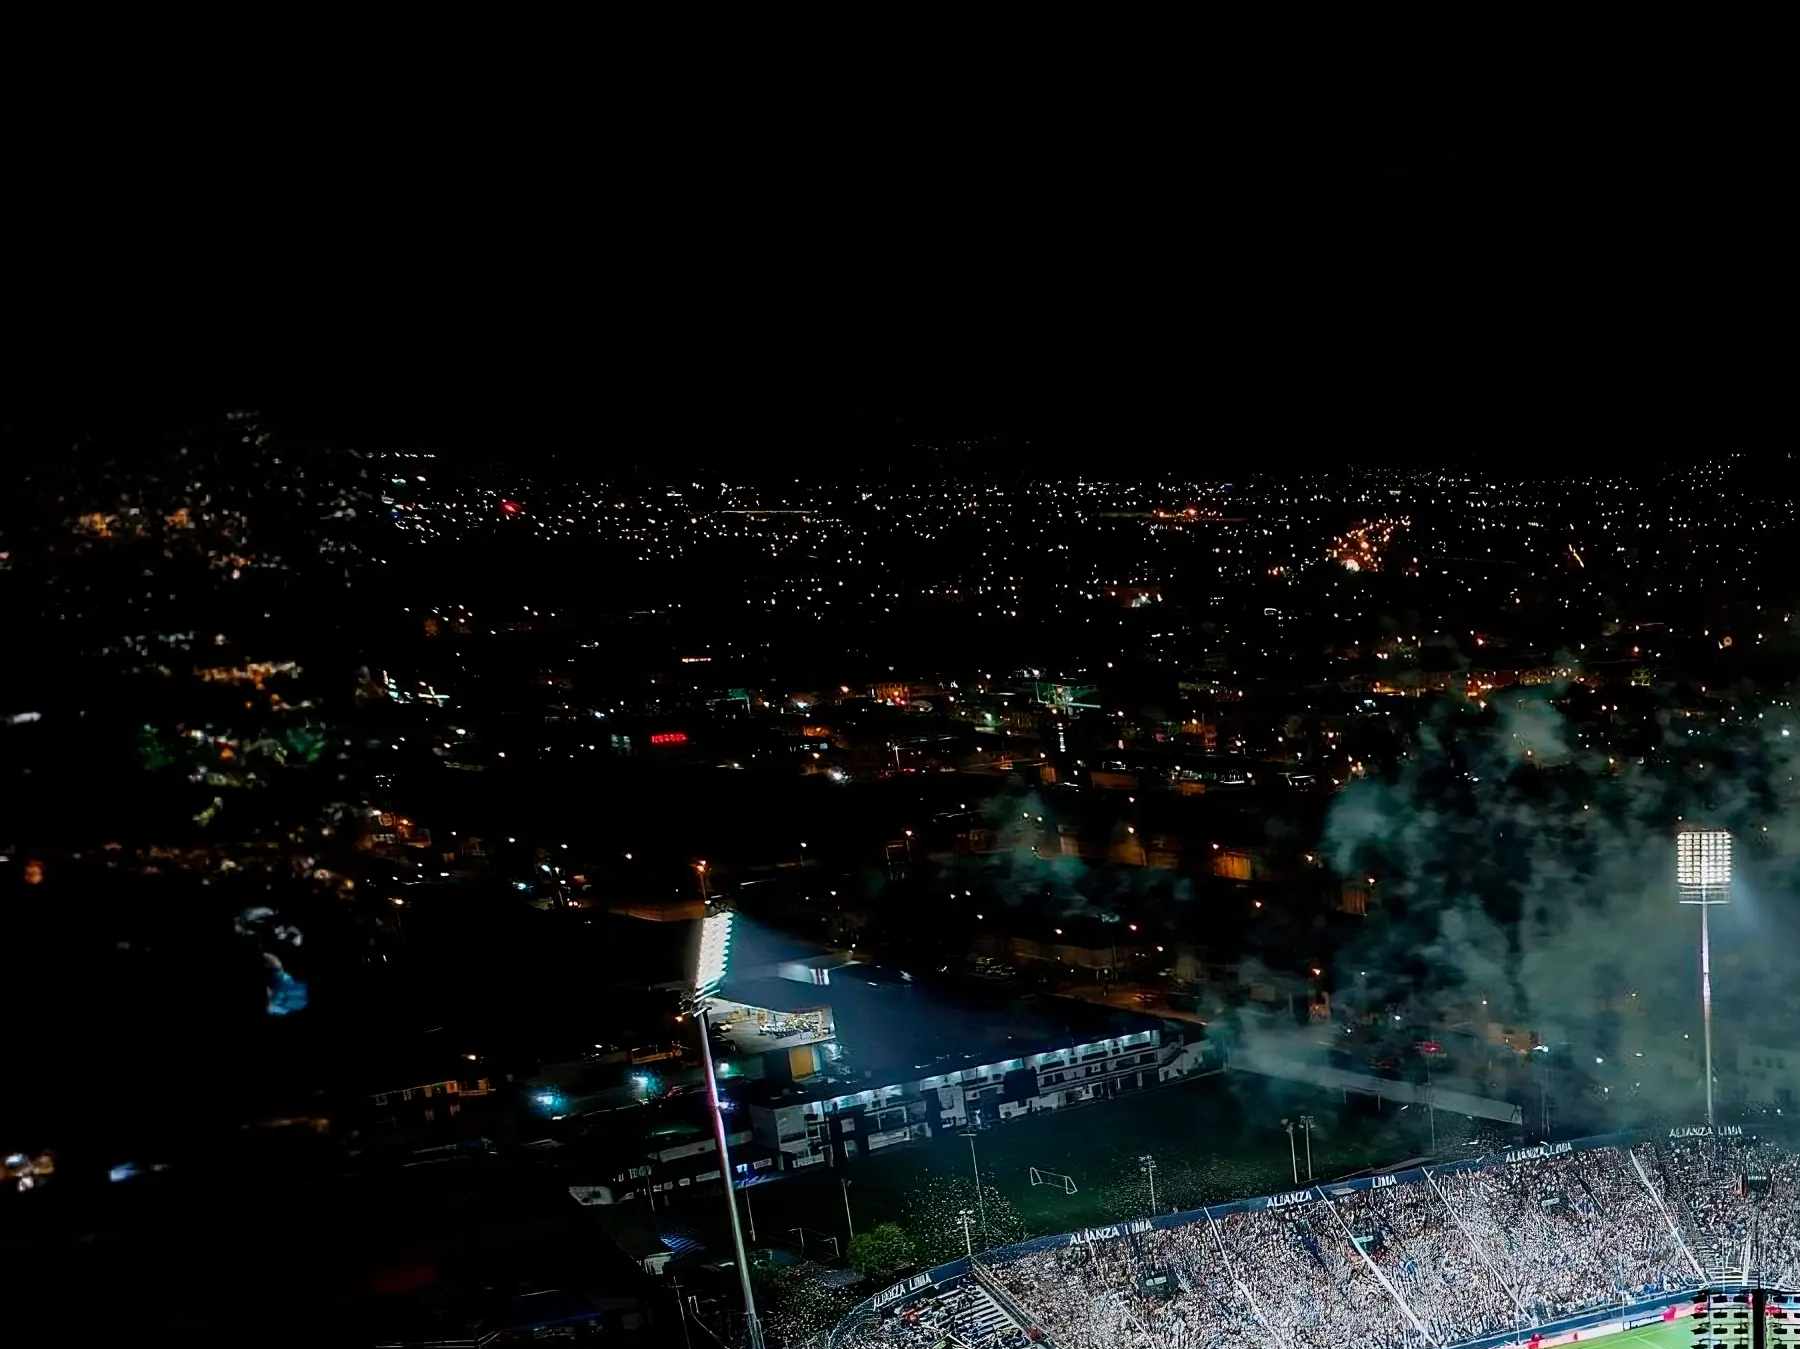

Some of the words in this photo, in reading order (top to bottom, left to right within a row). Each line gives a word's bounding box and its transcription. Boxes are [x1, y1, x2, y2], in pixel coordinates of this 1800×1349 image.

[1266, 1190, 1312, 1207] ALIANZA
[1372, 1174, 1397, 1189] LIMA
[1069, 1227, 1120, 1246] ALIANZA
